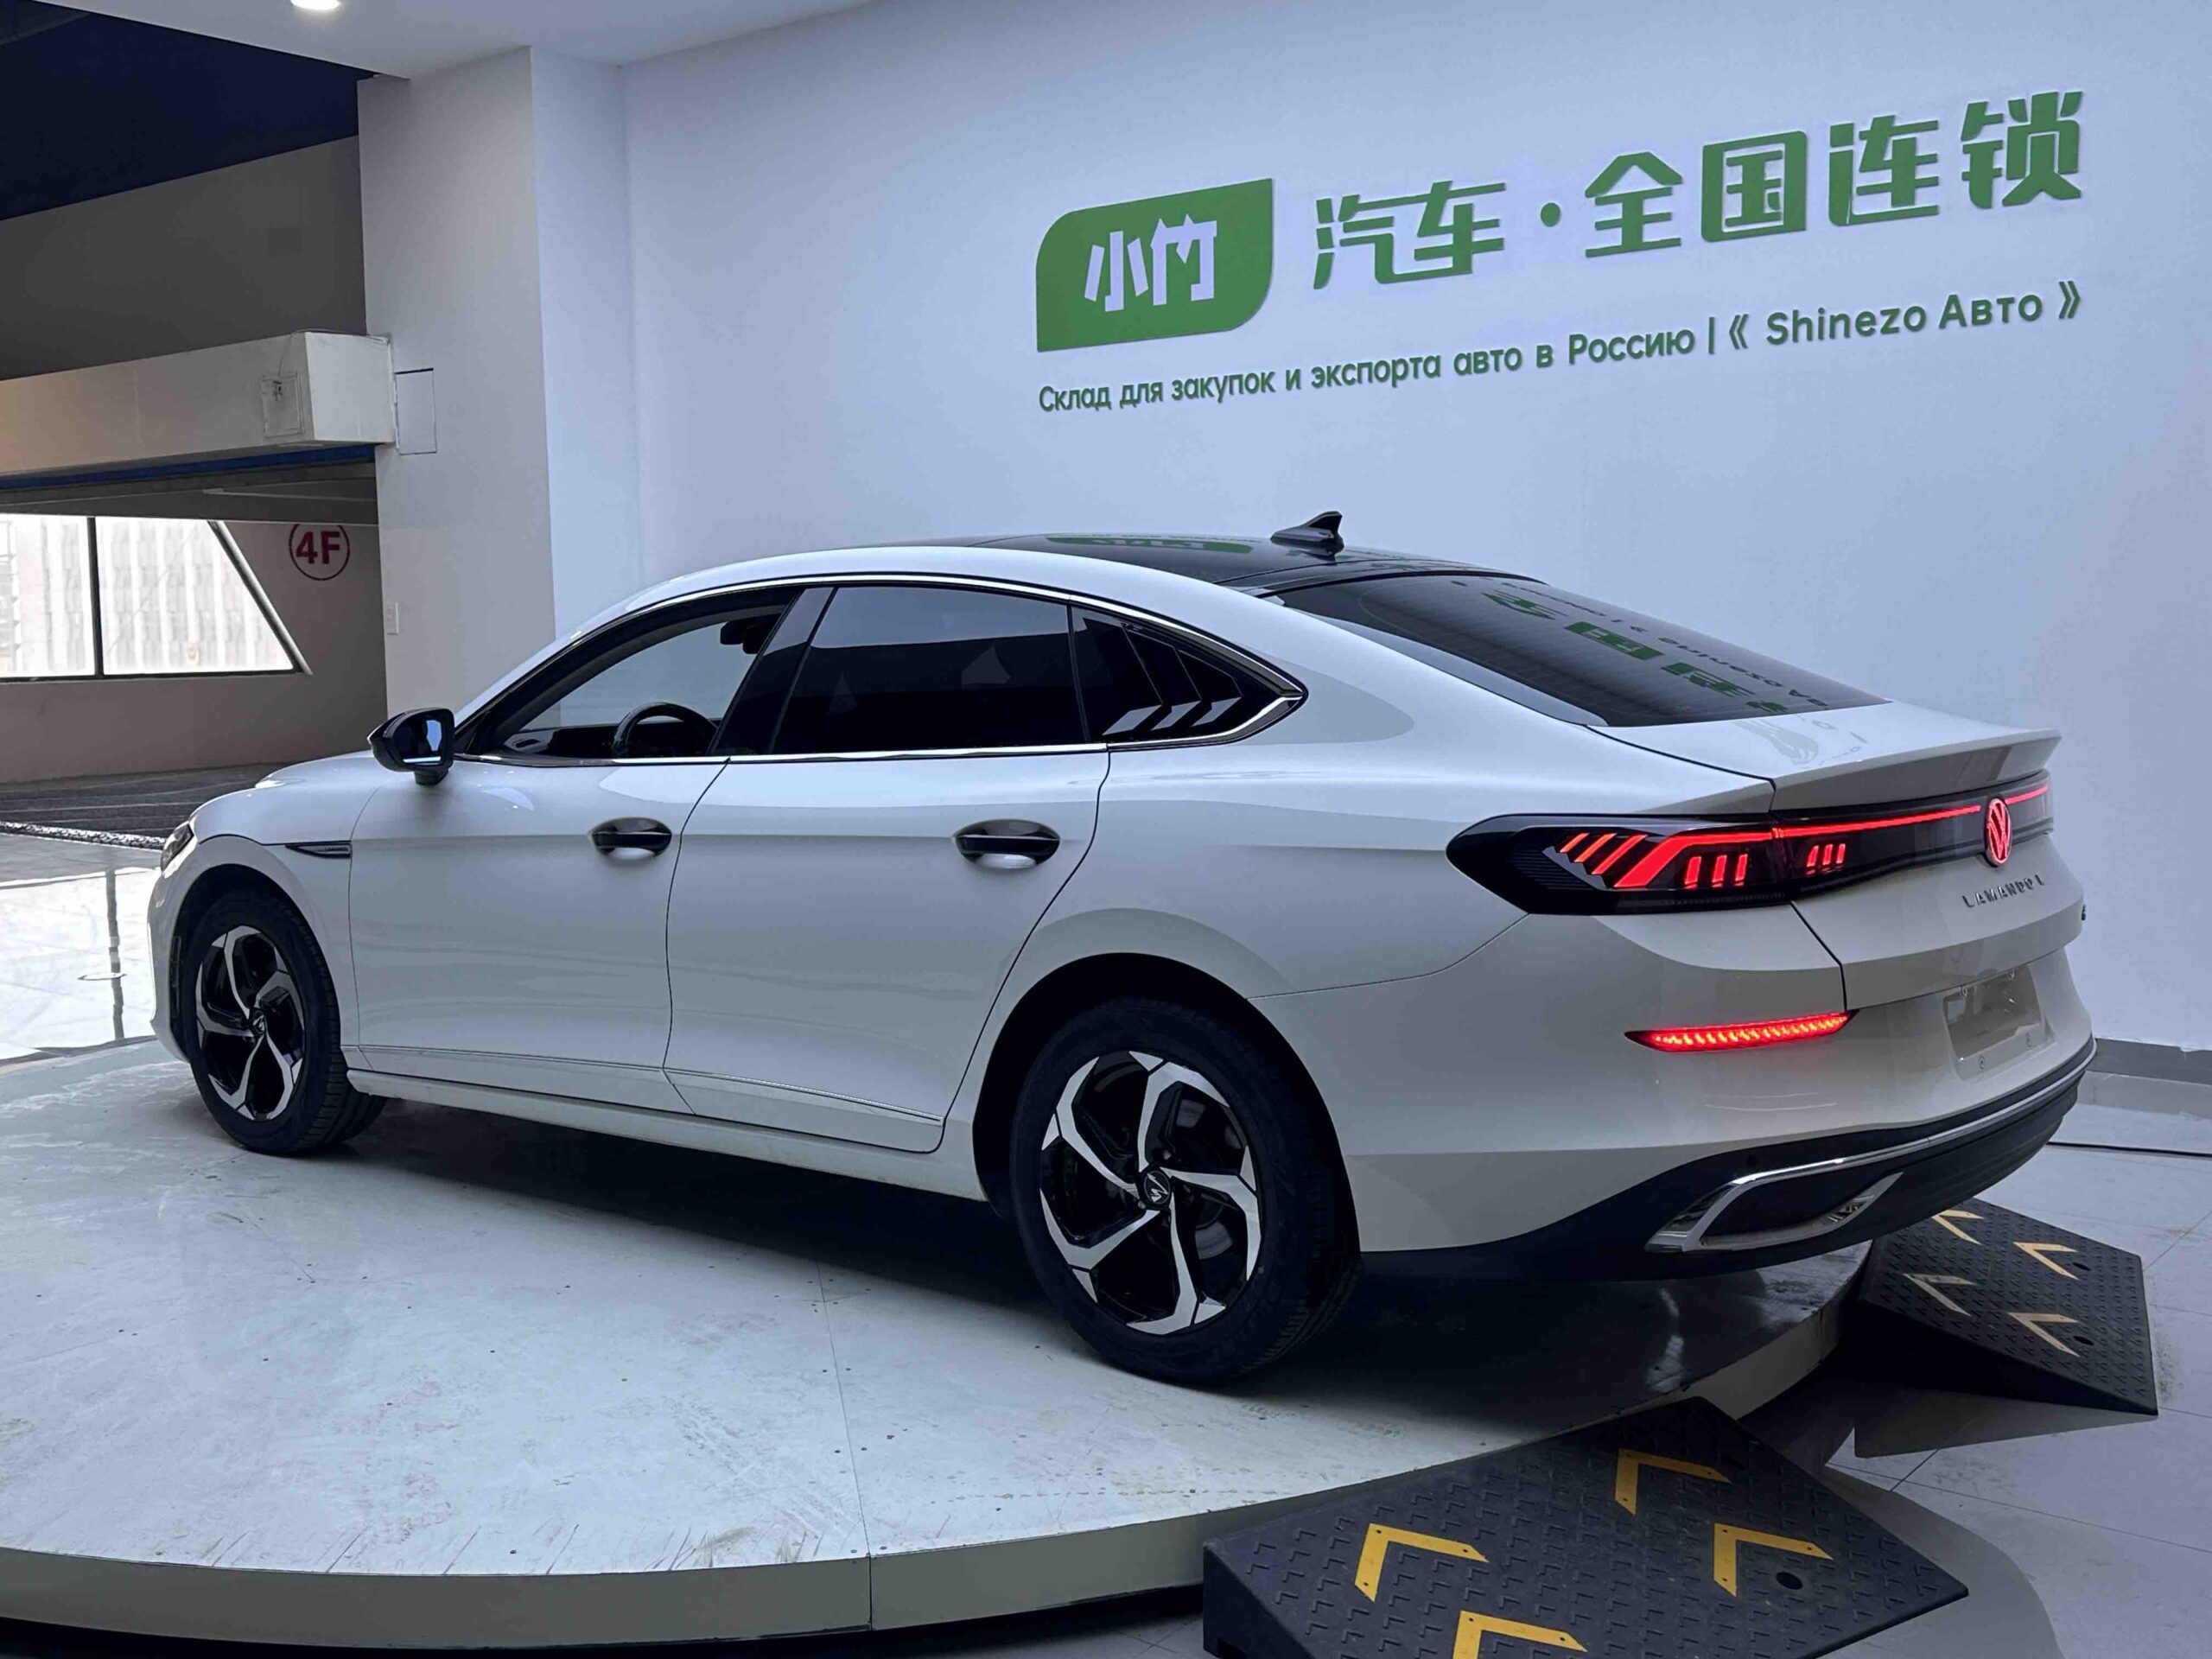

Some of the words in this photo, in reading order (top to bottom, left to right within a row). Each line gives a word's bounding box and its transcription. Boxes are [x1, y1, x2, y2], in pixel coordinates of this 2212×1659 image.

[1039, 383, 1112, 412] Склад
[1119, 381, 1163, 410] для
[1171, 371, 1275, 404] закупок
[1285, 368, 1301, 391] и
[1311, 355, 1441, 389] экспорта
[1453, 347, 1522, 376] авто
[1536, 345, 1554, 368] в
[1568, 329, 1695, 365] Россию
[296, 531, 340, 564] 4F
